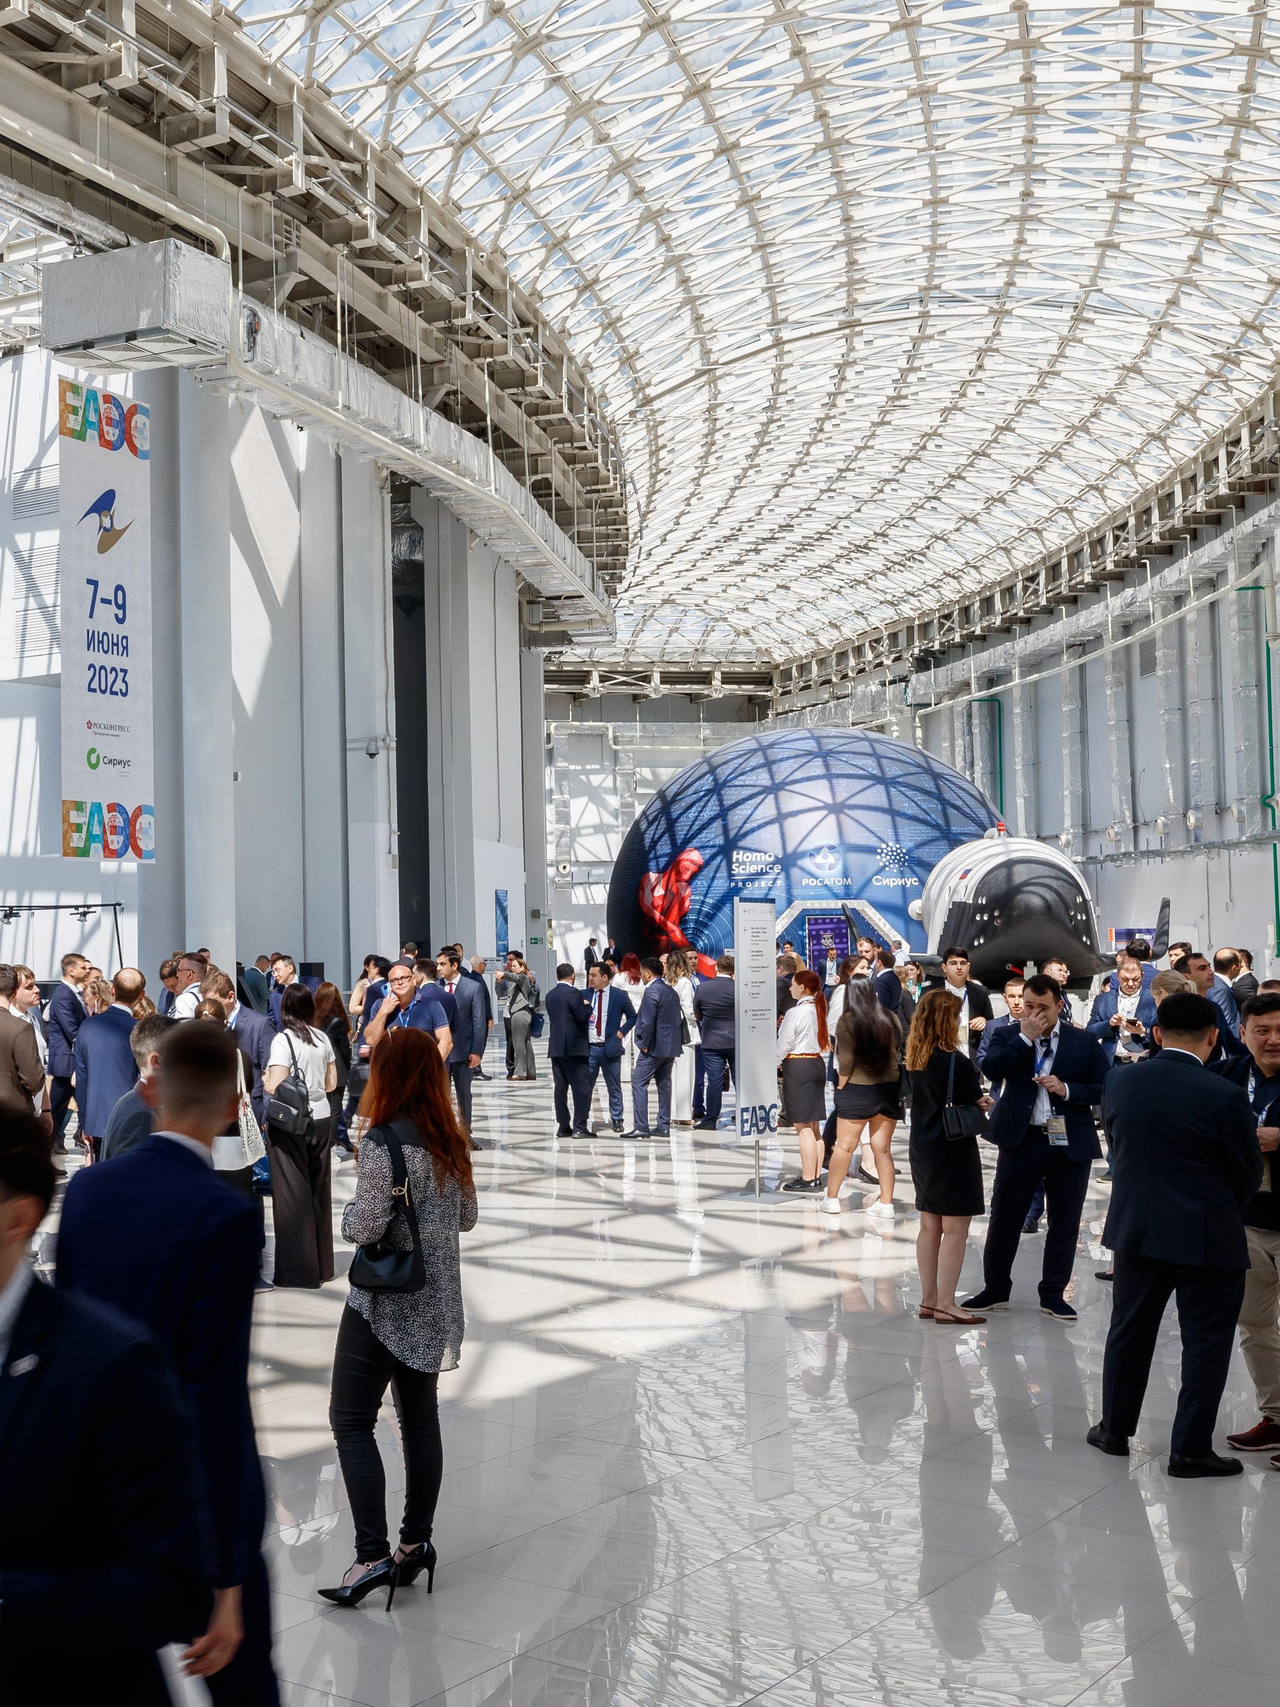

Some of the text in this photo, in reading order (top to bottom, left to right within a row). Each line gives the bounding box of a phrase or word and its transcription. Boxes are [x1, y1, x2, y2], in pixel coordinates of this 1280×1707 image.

[59, 378, 150, 461] ЕАЭС
[86, 628, 129, 658] ИЮНЯ
[87, 663, 129, 698] 2023
[93, 722, 132, 734] РОСКОНГРЕСС
[102, 755, 132, 769] Сириус
[62, 799, 155, 860] ЕАЭС
[732, 851, 775, 863] Homo
[732, 862, 782, 874] Science
[802, 878, 852, 886] РОСАТОМ
[872, 875, 919, 888] Сириус
[740, 1103, 778, 1136] ЕАЭС
